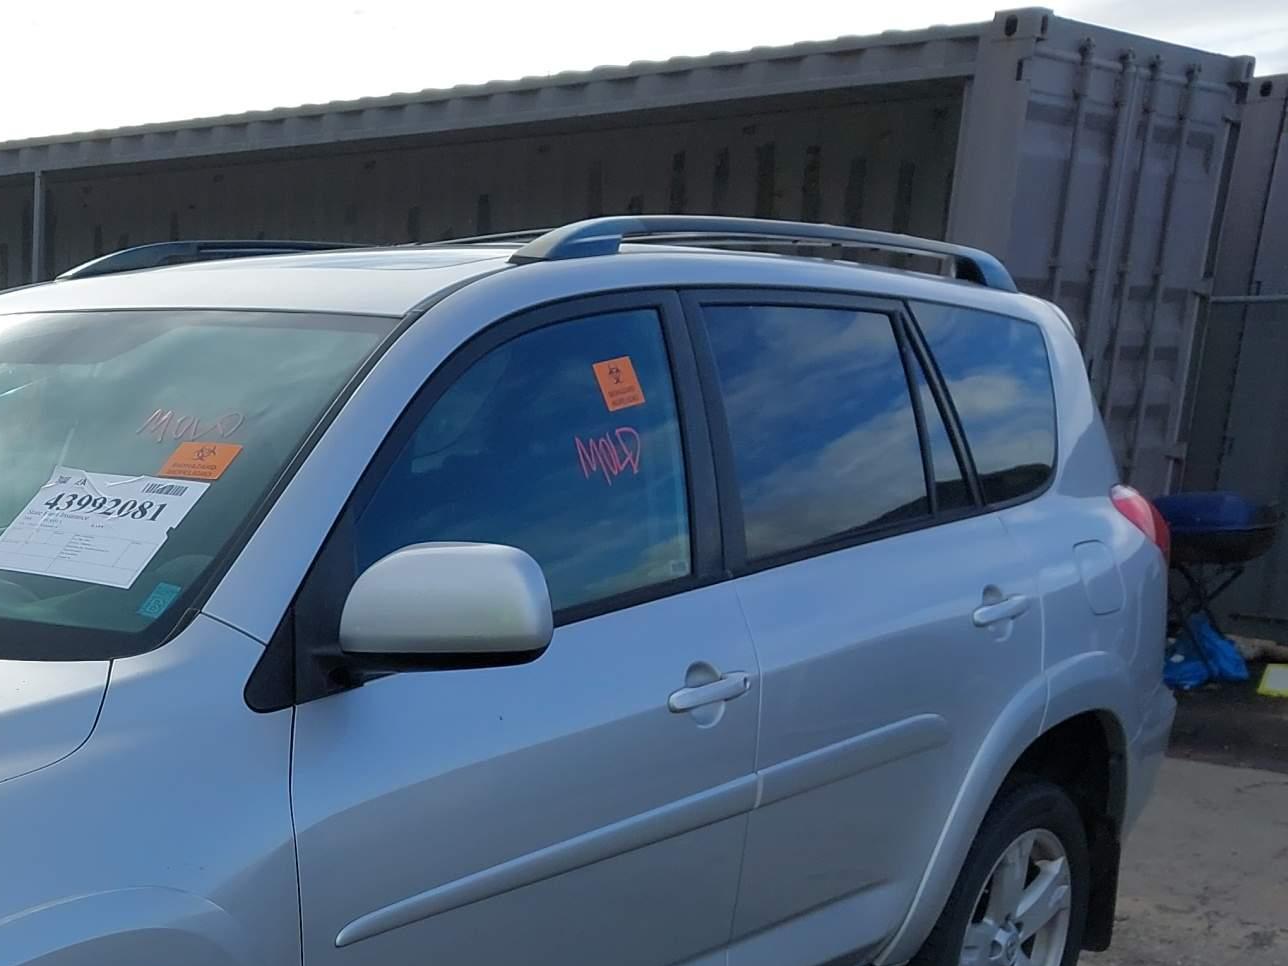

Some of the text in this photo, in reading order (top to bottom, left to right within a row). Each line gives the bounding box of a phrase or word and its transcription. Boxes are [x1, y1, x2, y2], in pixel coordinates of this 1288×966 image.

[136, 408, 246, 444] MOLD
[574, 426, 641, 487] MOLD
[44, 492, 167, 522] 43992081
